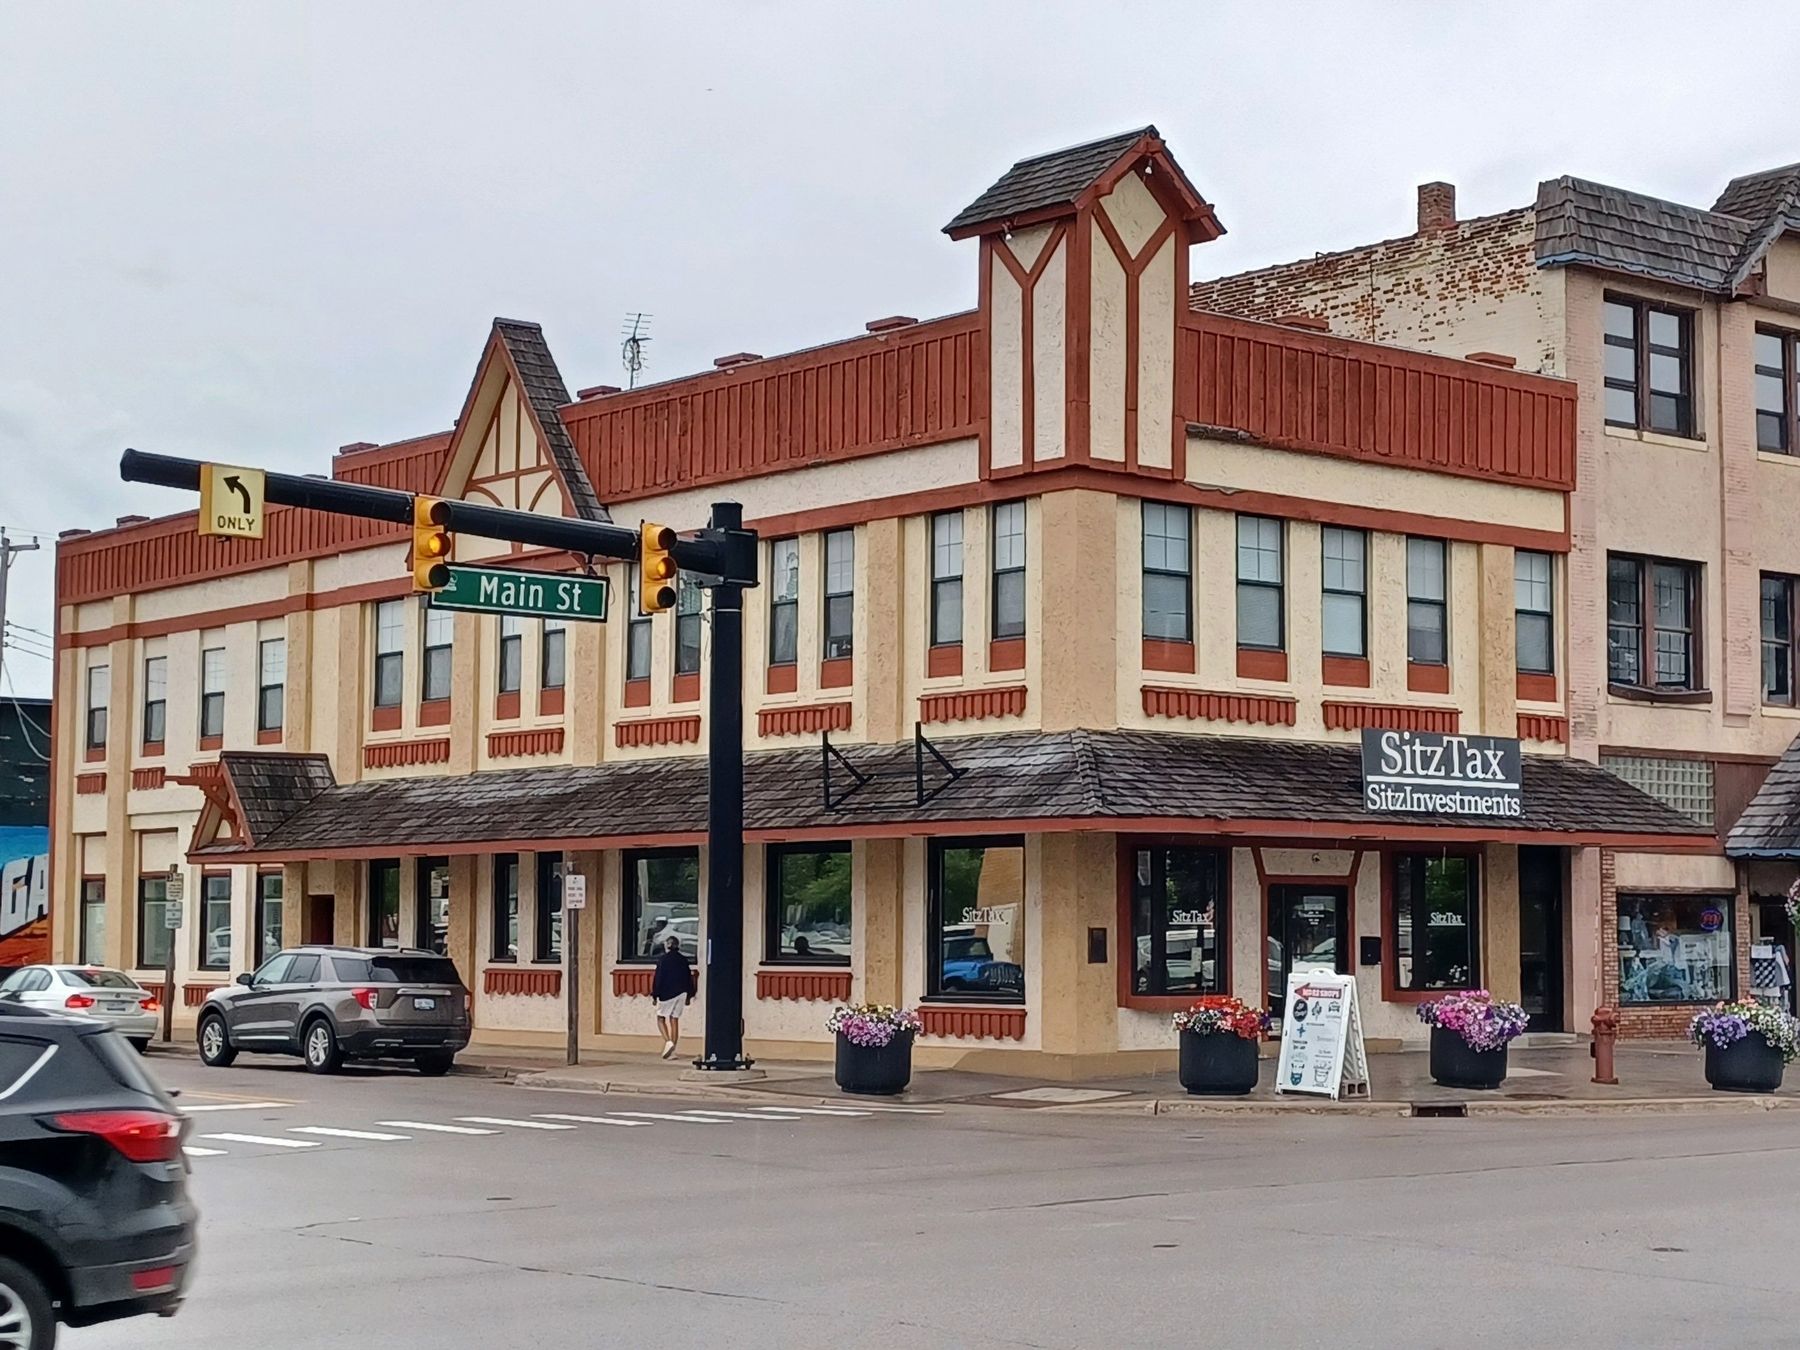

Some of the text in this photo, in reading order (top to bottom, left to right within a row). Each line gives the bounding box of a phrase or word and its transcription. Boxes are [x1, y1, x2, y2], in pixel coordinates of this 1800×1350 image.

[217, 515, 255, 531] ONLY
[479, 575, 582, 611] Main St
[1381, 731, 1506, 780] SitzTax
[1367, 784, 1520, 816] SitzInvestments
